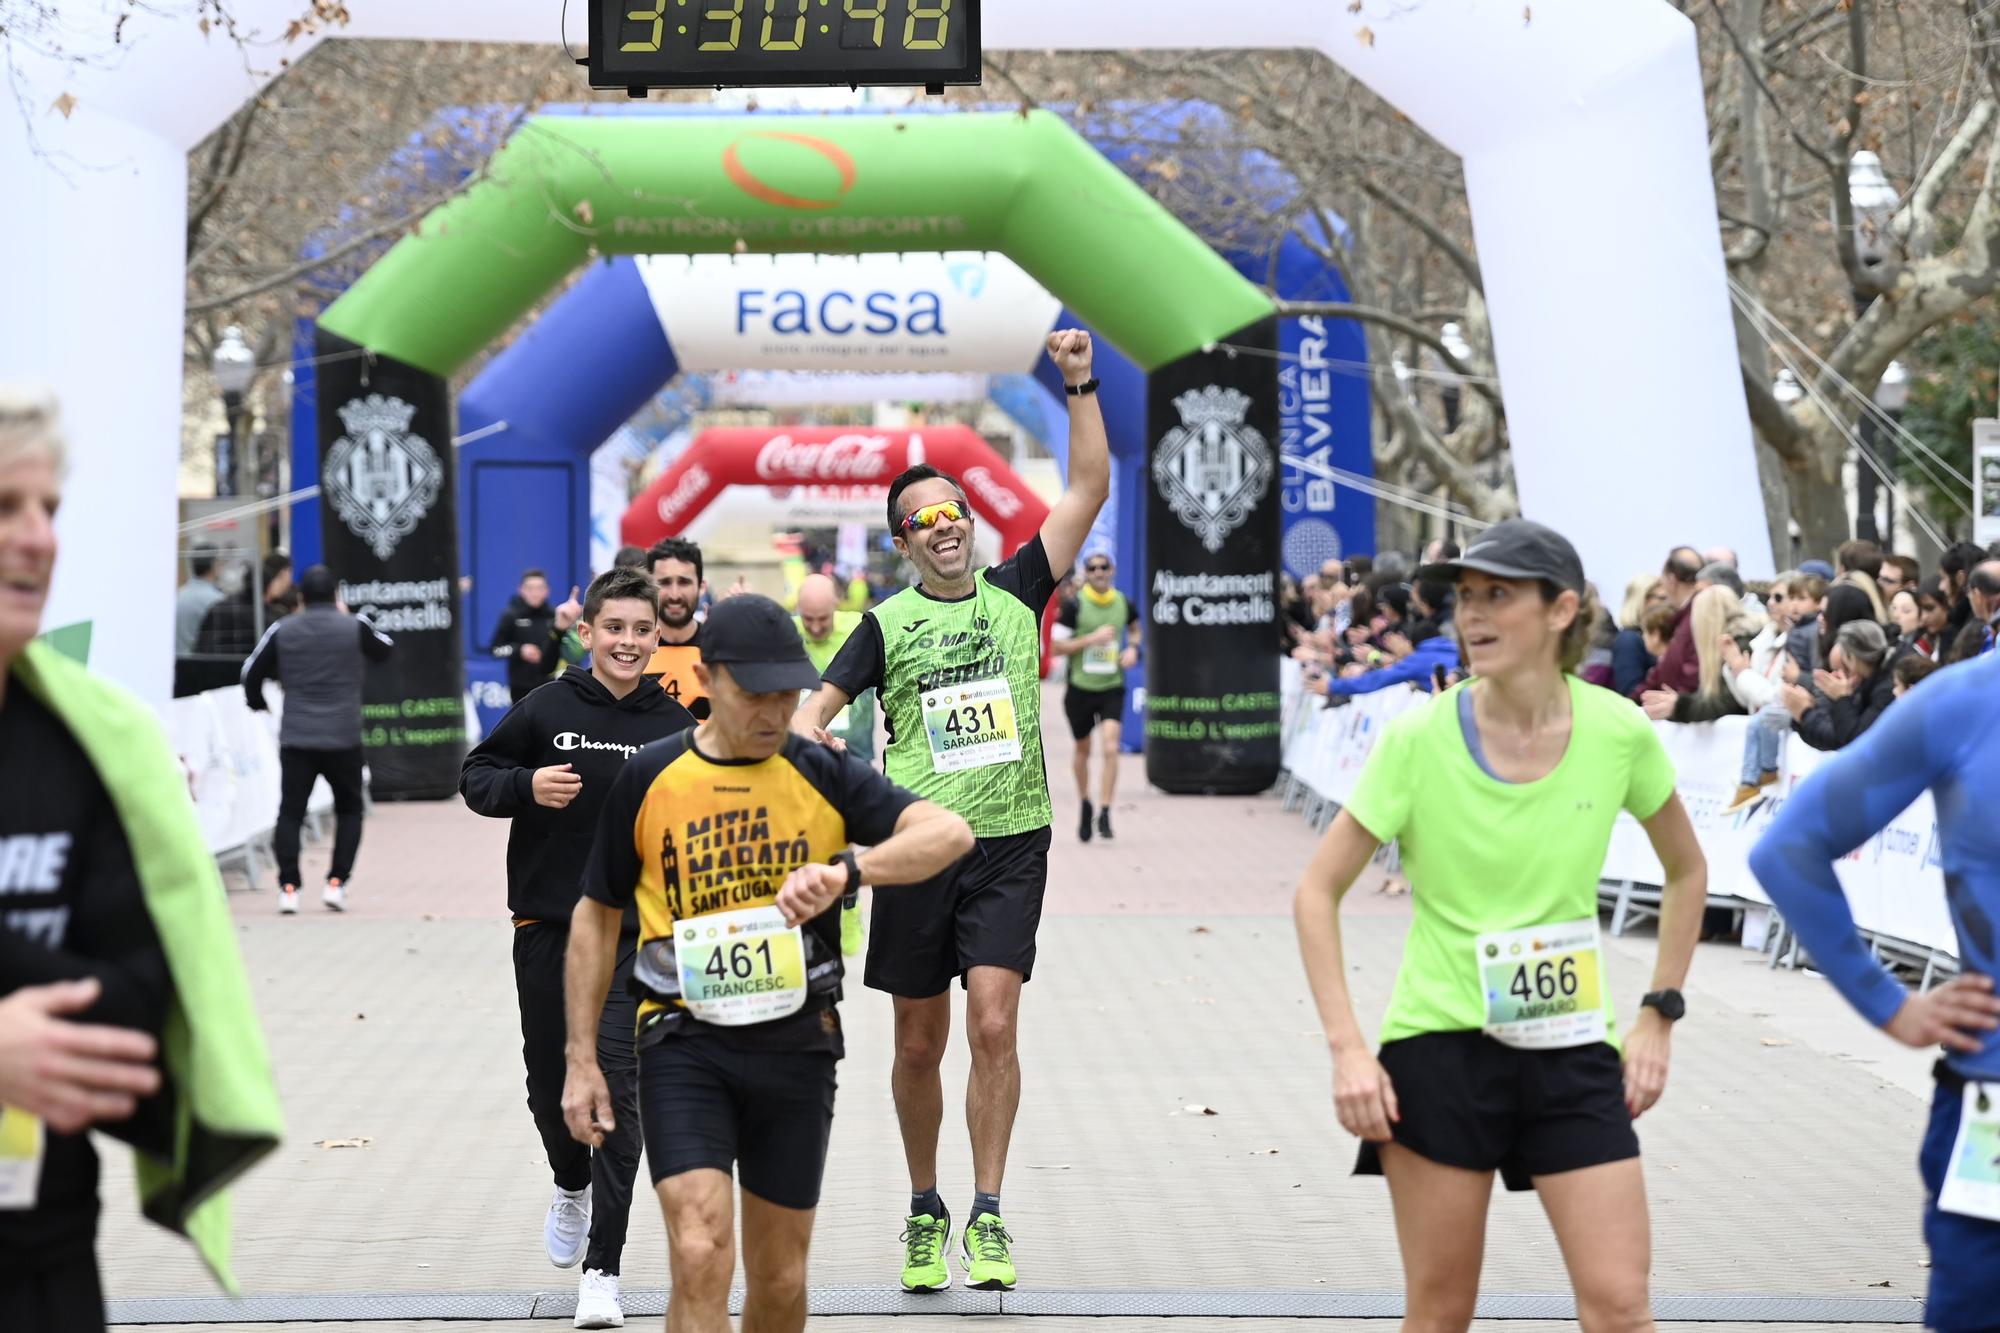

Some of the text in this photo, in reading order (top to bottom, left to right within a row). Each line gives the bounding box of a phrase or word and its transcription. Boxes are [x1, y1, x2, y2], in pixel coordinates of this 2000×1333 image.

[1153, 569, 1274, 599] Ajuntament
[1153, 597, 1180, 625] de
[945, 703, 996, 736] 431
[553, 732, 643, 759] Champ
[943, 730, 1007, 750] SARA&DANI
[691, 880, 777, 915] SANT CUGA
[705, 939, 773, 981] 461
[703, 976, 785, 999] FRANCESC
[1510, 956, 1577, 1002] 466
[1515, 999, 1577, 1020] AMPARO
